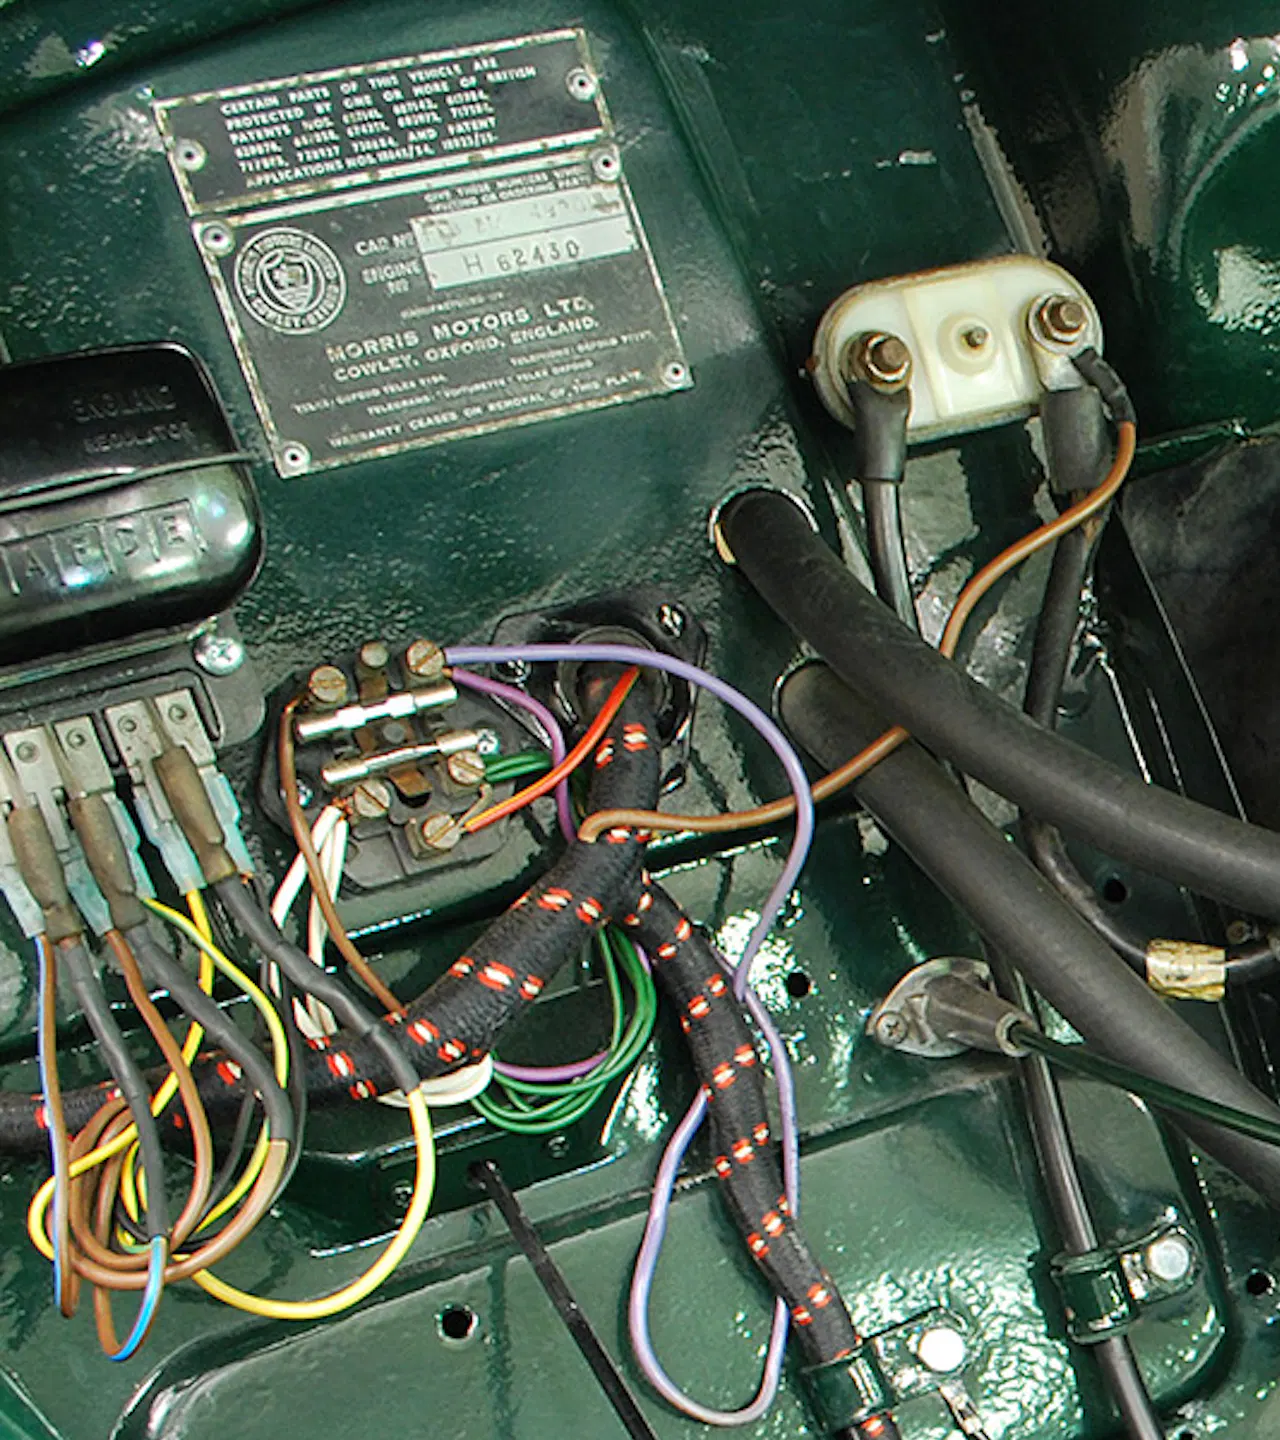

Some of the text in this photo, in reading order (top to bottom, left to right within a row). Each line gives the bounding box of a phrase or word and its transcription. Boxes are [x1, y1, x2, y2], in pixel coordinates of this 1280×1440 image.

[220, 56, 499, 117] CERTAIN PARTS OF THIS VEHICLE ARE
[225, 107, 305, 131] PROTECTED
[314, 101, 332, 115] BY
[342, 94, 373, 110] ONE
[383, 89, 404, 102] OR
[412, 80, 450, 97] MORE
[459, 75, 477, 88] OF
[486, 65, 537, 83] BRITISH
[229, 123, 292, 145] PATENTS
[407, 127, 438, 143] AND
[447, 116, 496, 136] PATENT
[247, 159, 344, 188] APPLICATIONS
[354, 235, 390, 256] CAR
[362, 260, 422, 285] ENGINE
[325, 331, 419, 363] MORRIS
[431, 306, 531, 341] MOTORS
[510, 316, 599, 345] ENGLAND.
[327, 423, 403, 449] WARRANTY
[407, 411, 458, 431] CEASES
[487, 391, 545, 412] REMOVAL
